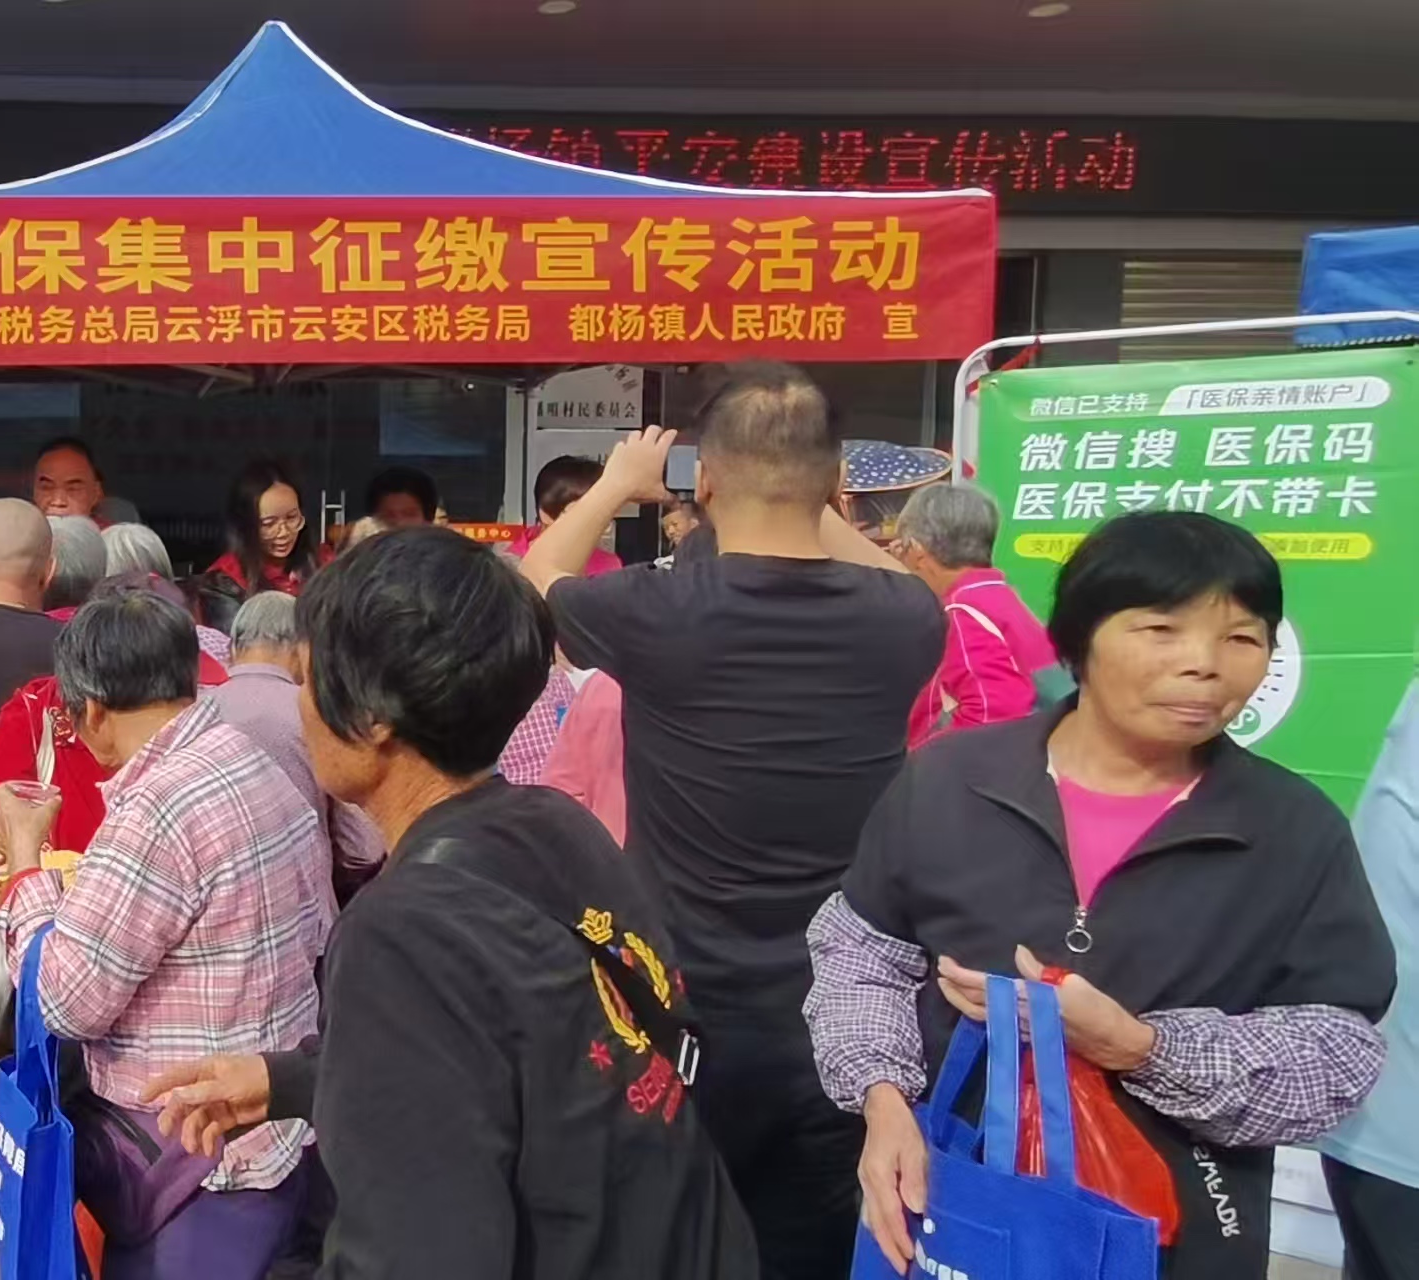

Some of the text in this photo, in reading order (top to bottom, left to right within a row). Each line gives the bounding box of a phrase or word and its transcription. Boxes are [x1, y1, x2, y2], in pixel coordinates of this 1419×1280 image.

[568, 302, 846, 343] 都杨镇人民政府
[882, 301, 920, 341] 宣
[1030, 393, 1149, 416] 微信已支持
[1019, 422, 1374, 472] 微信搜 医保码
[1012, 475, 1378, 520] 医保支付不带卡
